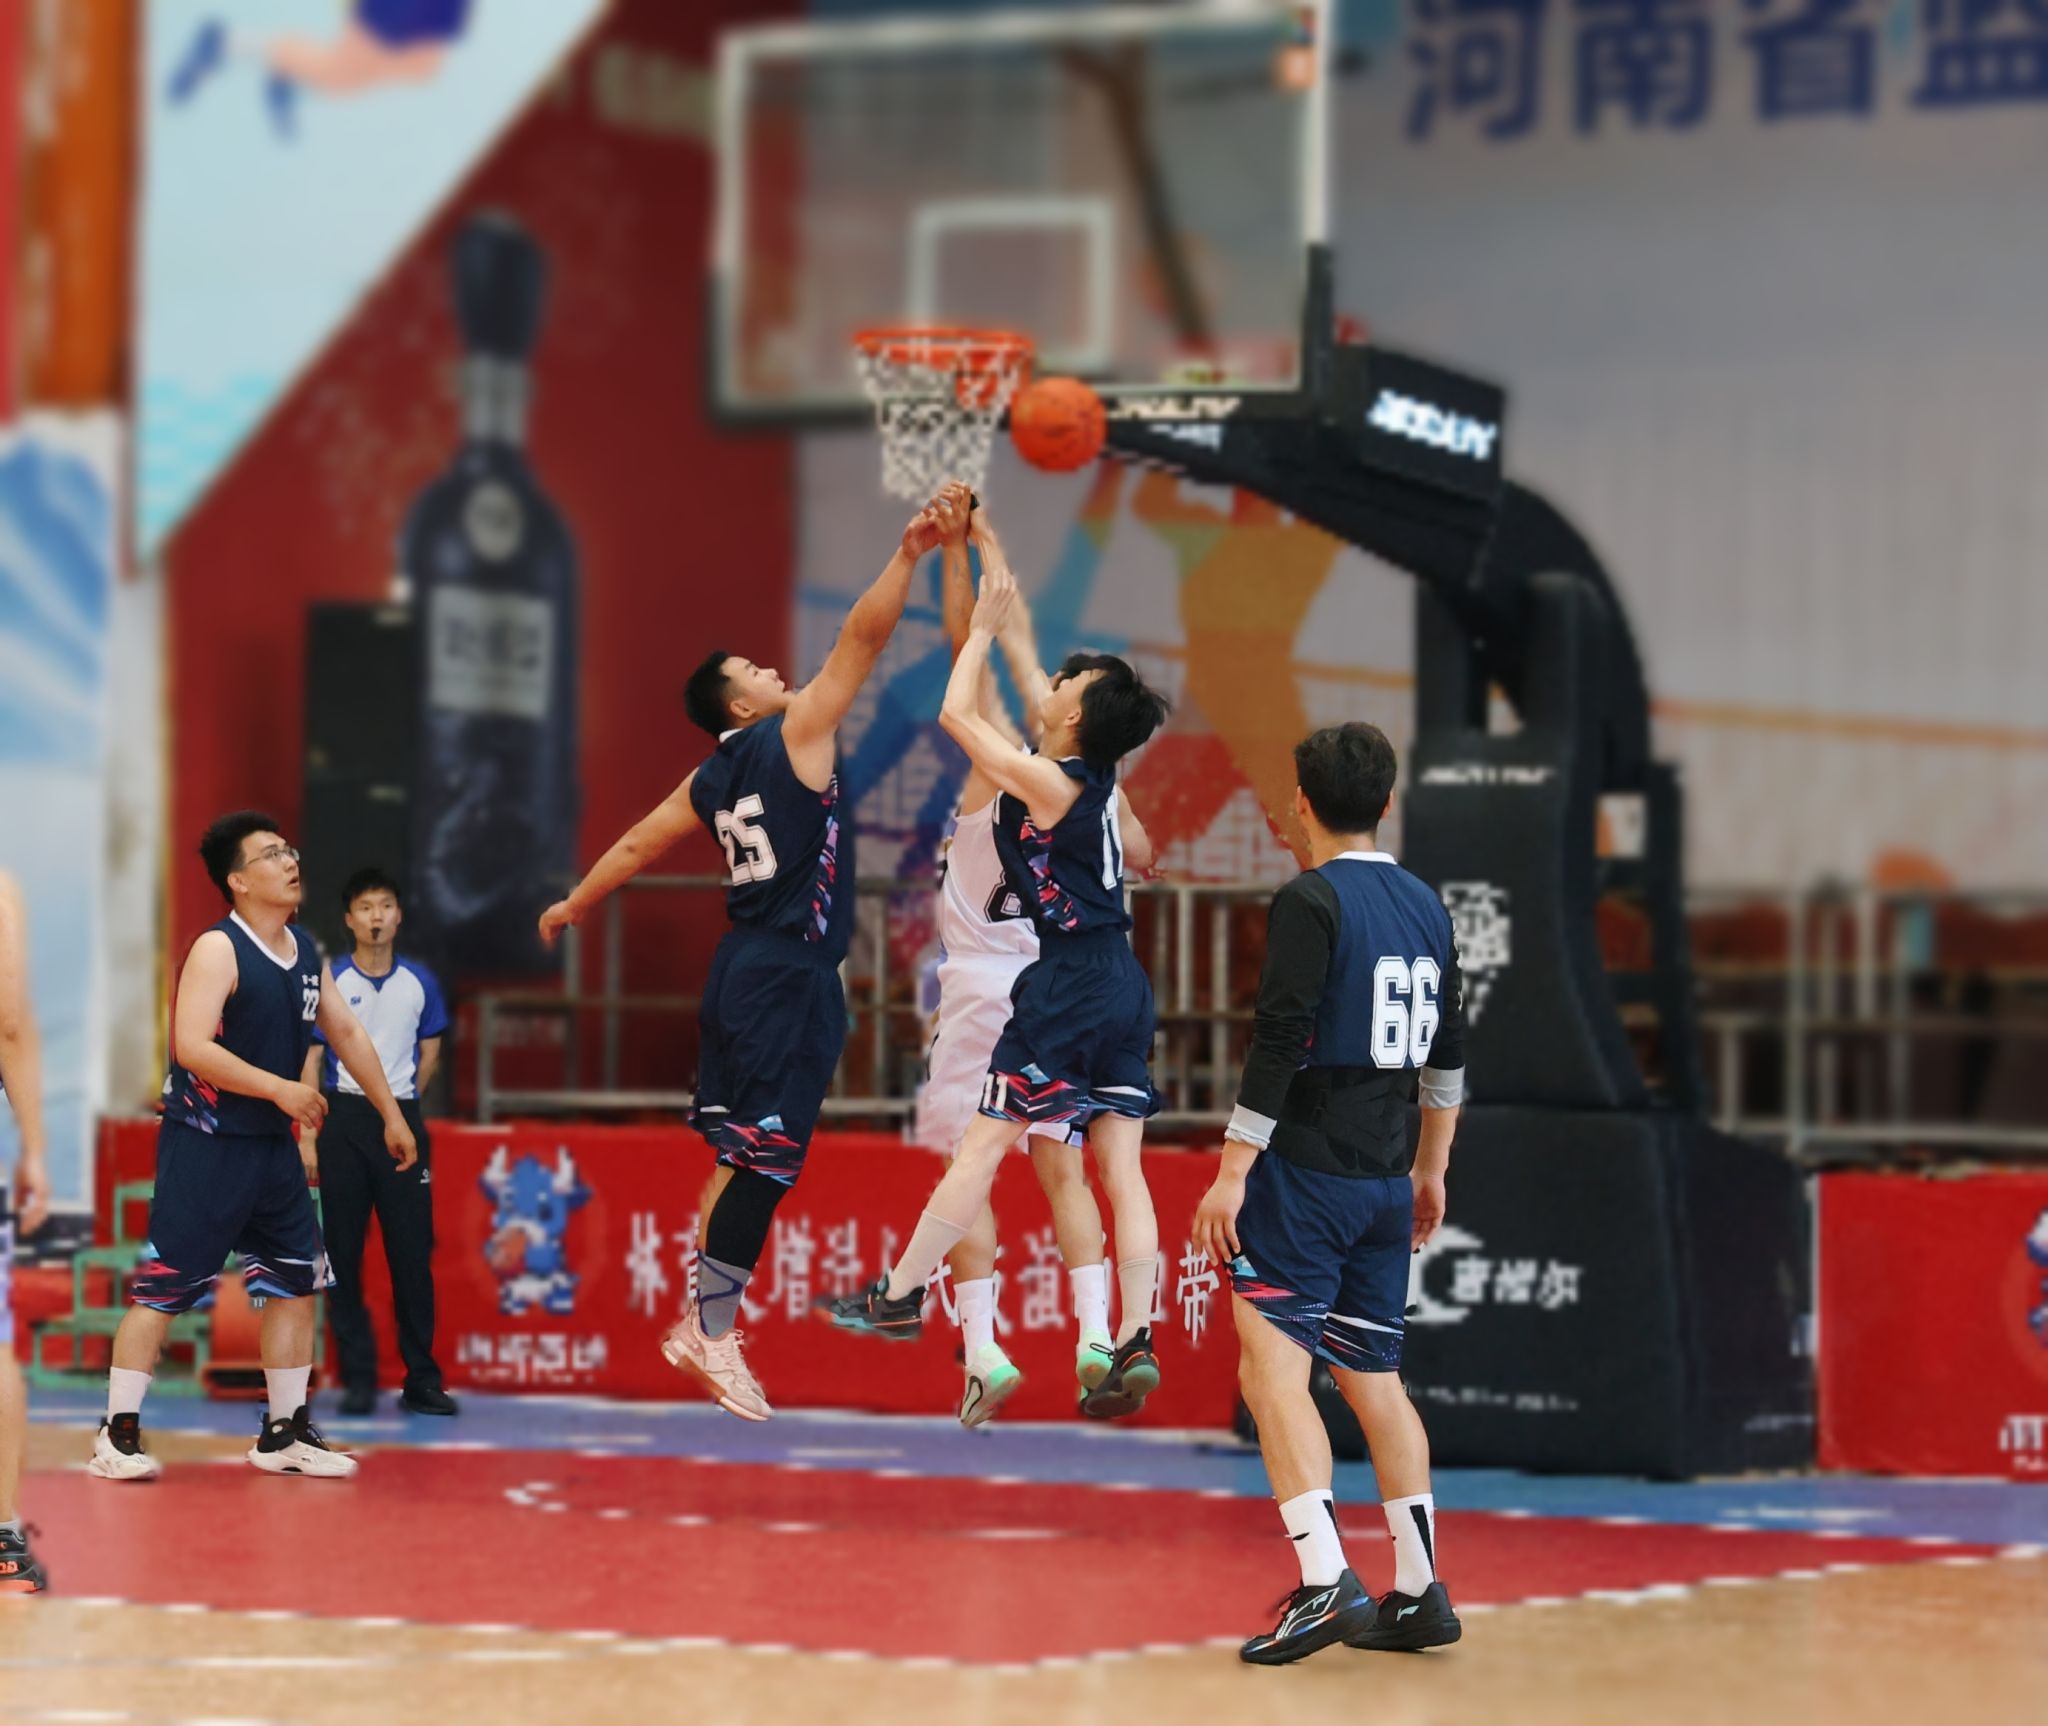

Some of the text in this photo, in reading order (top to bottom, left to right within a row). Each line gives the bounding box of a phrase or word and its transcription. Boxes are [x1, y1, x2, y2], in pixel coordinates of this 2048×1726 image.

[715, 793, 777, 886] 25
[302, 988, 320, 1021] 22
[1370, 956, 1440, 1069] 66
[983, 1073, 1008, 1111] 11
